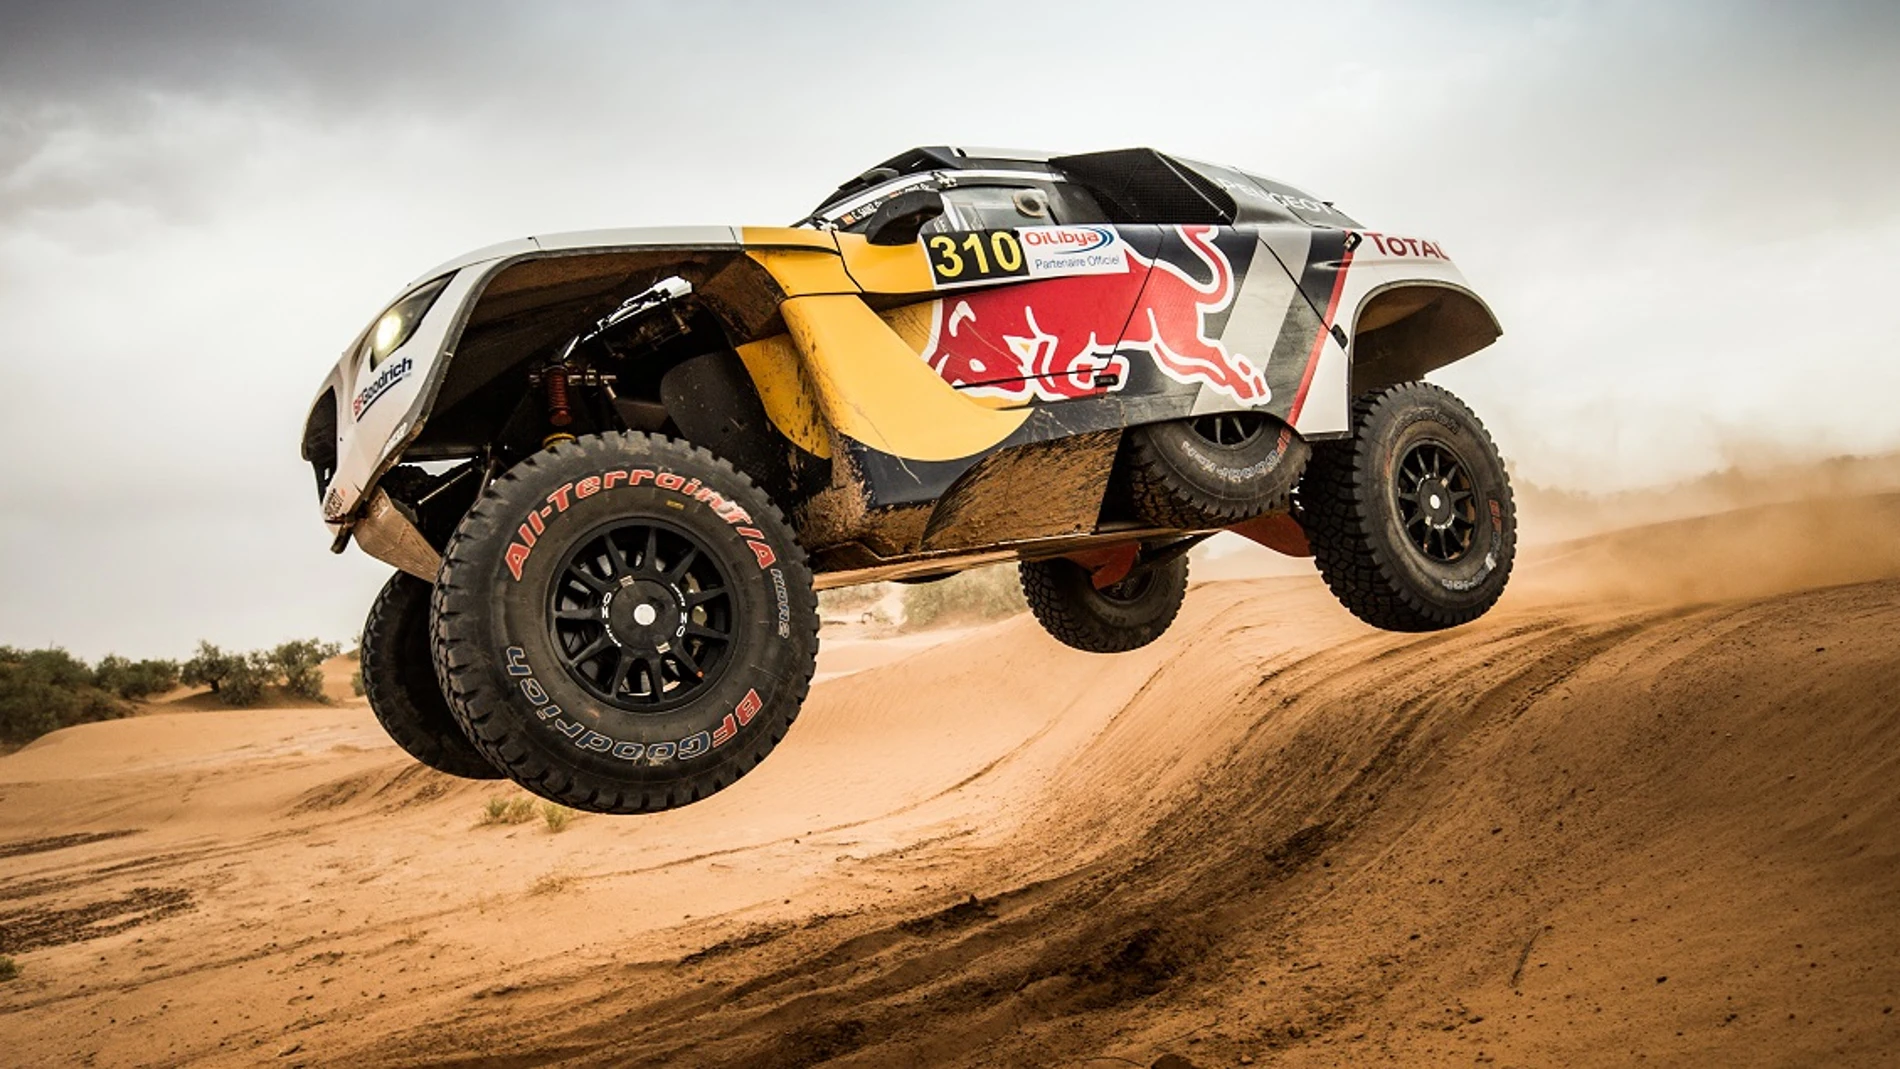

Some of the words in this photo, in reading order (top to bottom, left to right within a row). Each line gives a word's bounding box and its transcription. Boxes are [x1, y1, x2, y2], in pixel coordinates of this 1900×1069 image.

[929, 231, 1022, 277] 310
[1025, 229, 1099, 247] OiLibya
[1363, 232, 1451, 261] TOTAL
[1034, 256, 1086, 270] Partenaire
[1086, 255, 1121, 267] Officiel
[352, 357, 413, 417] BFGoodrich
[503, 468, 724, 582] All-Terrain
[505, 645, 764, 761] BFGoodrich
